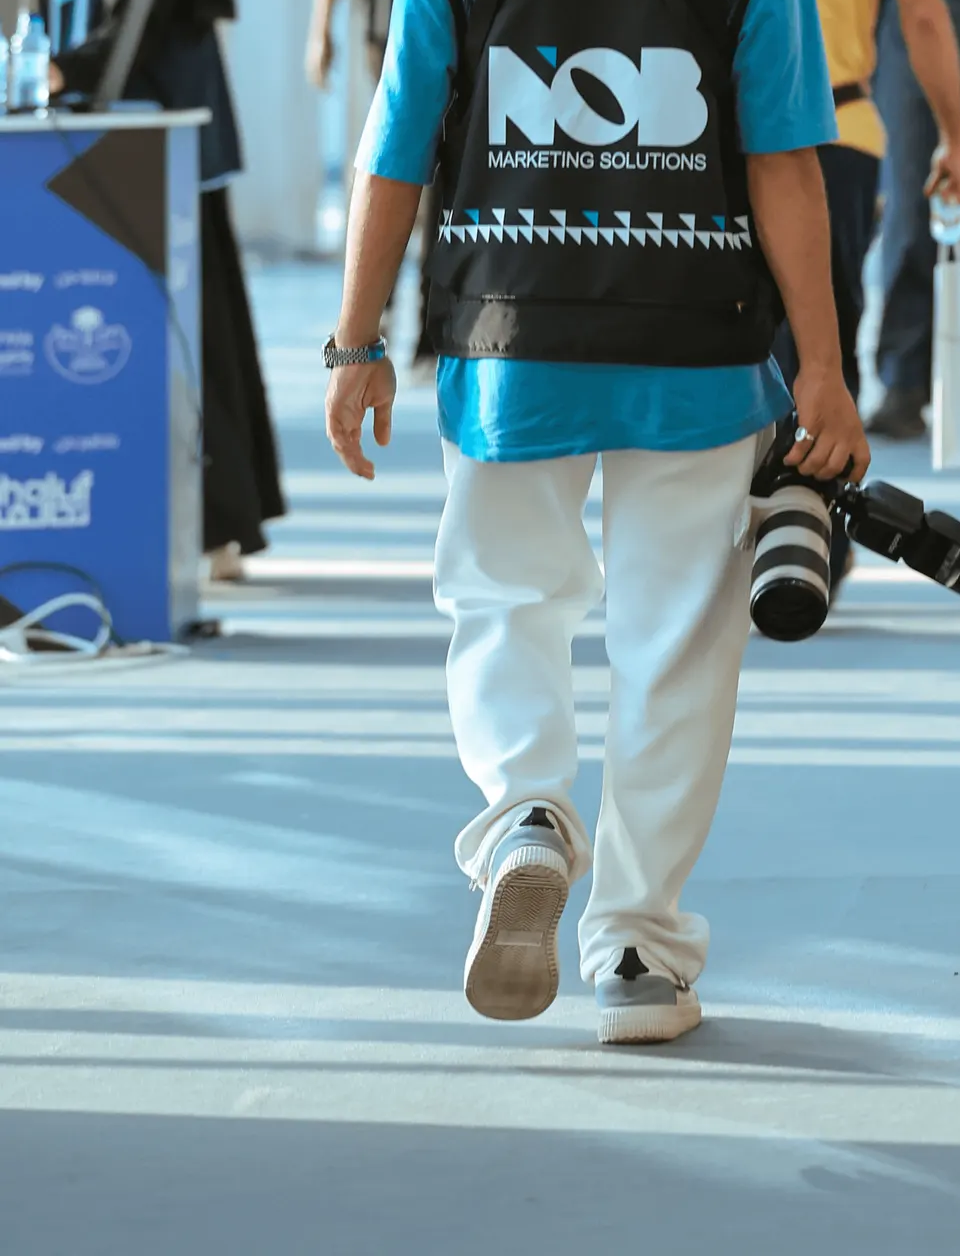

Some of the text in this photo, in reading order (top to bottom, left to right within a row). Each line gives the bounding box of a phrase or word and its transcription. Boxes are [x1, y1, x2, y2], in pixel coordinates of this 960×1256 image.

[488, 46, 708, 147] NOB
[488, 151, 707, 171] MARKETING SOLUTIONS
